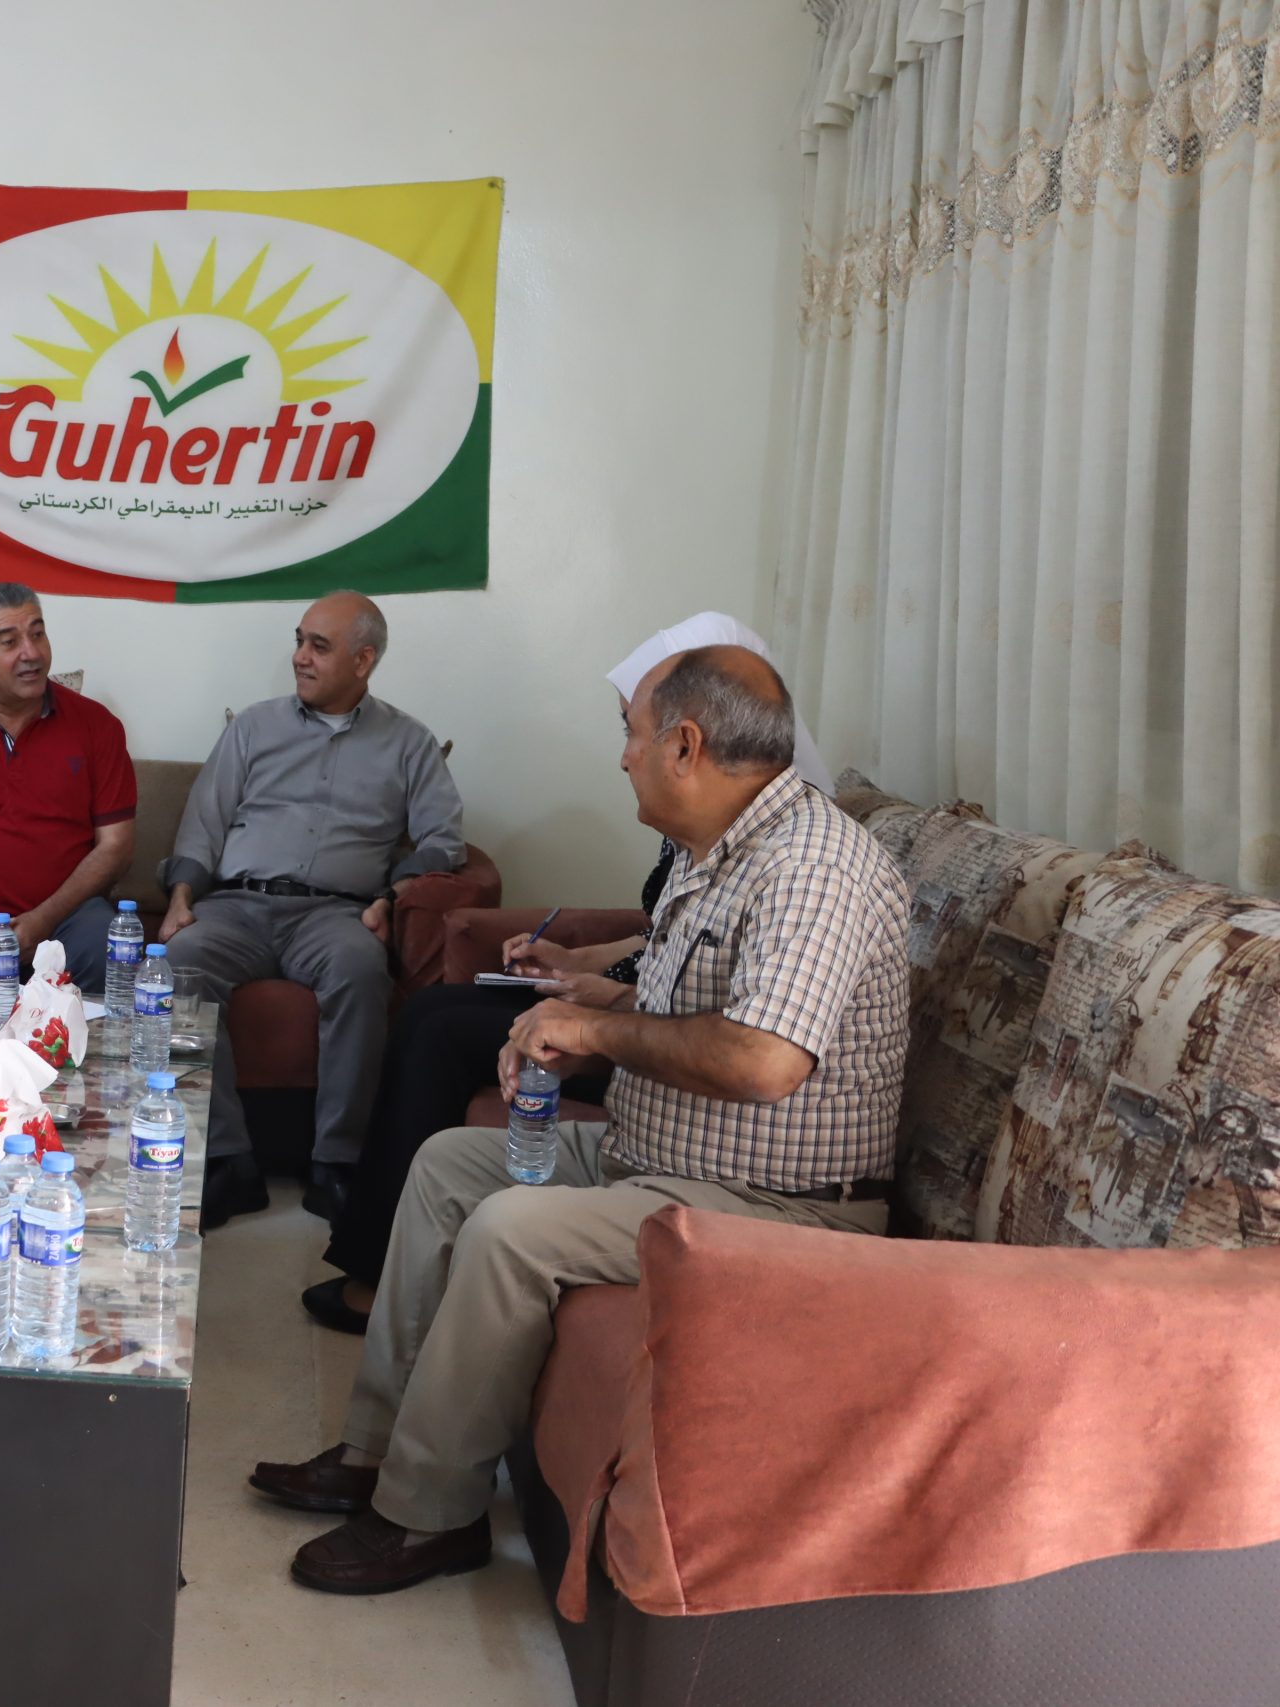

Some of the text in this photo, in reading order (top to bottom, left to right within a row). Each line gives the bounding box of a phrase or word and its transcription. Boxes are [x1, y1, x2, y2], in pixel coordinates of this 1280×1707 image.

[19, 492, 328, 520] حزب التغيير الديمقراطي الكردستاني
[150, 1147, 180, 1158] Tiyan
